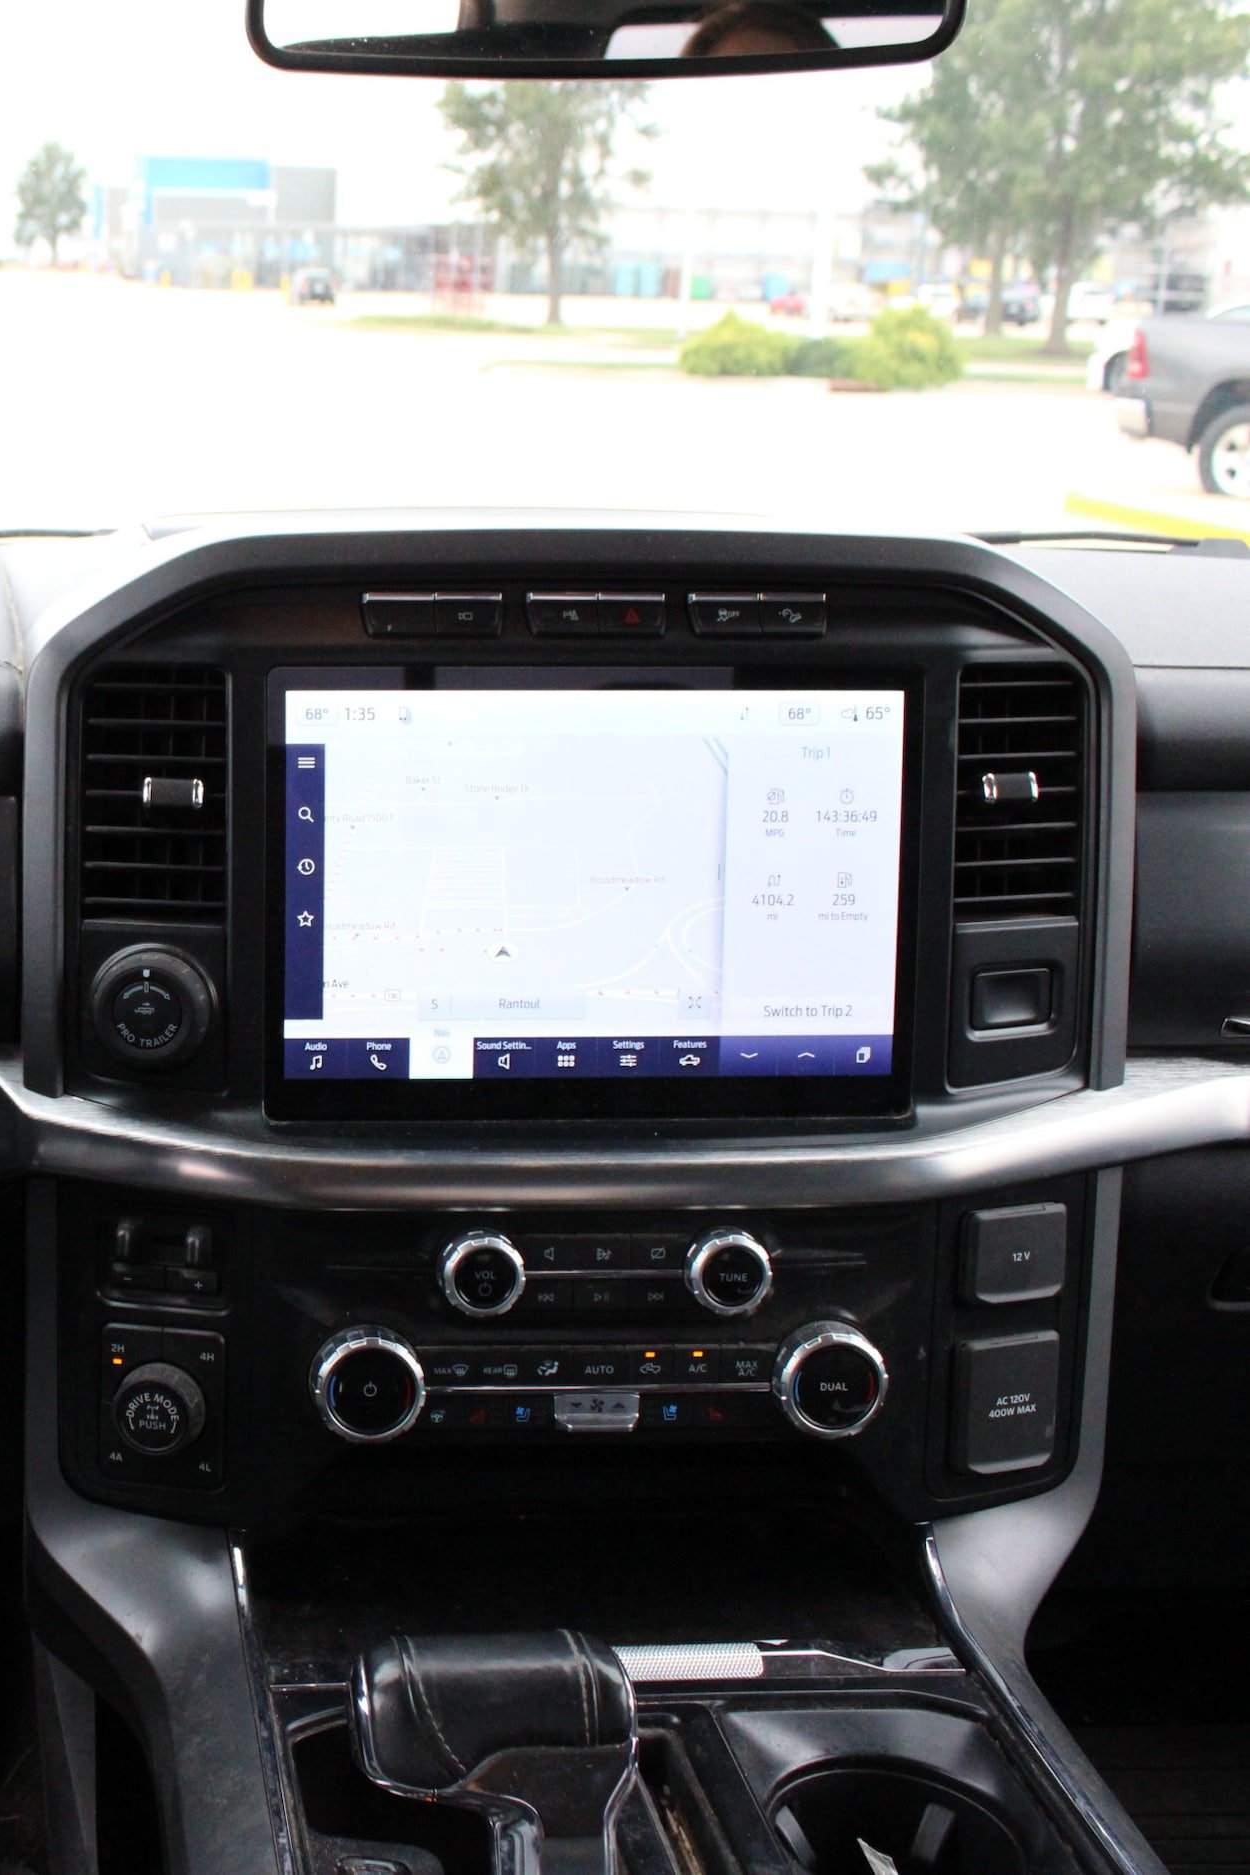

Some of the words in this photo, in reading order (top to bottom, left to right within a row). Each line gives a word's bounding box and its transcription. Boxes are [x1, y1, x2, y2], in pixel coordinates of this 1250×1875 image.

[305, 708, 329, 721] 68°
[344, 707, 376, 721] 1:35
[788, 707, 811, 721] 68°
[865, 706, 890, 721] 65°
[800, 746, 823, 761] Trip
[405, 776, 430, 785] Baker
[343, 813, 365, 822] Road
[762, 810, 789, 823] 20.8
[816, 810, 877, 823] 143:36:49
[765, 828, 784, 838] MPG
[836, 828, 857, 838] Time
[654, 875, 665, 885] Rd
[751, 893, 794, 907] 4104.2
[832, 894, 855, 906] 259
[767, 912, 778, 921] mi
[818, 912, 829, 921] mi
[830, 912, 840, 921] to
[840, 912, 868, 922] Empty
[331, 978, 349, 989] Ave
[431, 998, 438, 1010] S
[498, 998, 540, 1010] Rantoul
[763, 1005, 801, 1018] Switch
[803, 1006, 818, 1018] to
[821, 1005, 842, 1019] Trip
[845, 1005, 852, 1017] 2
[116, 1022, 136, 1043] PRO
[139, 1023, 178, 1048] TRAILER
[433, 1029, 450, 1038] Nav
[304, 1042, 328, 1051] Audio
[366, 1041, 392, 1051] Phone
[476, 1041, 502, 1050] Sound
[556, 1040, 577, 1051] Apps
[612, 1040, 645, 1051] Settings
[673, 1040, 707, 1049] Features
[1012, 1251, 1022, 1262] 12
[1023, 1250, 1031, 1261] V
[474, 1270, 496, 1280] VOL
[718, 1272, 748, 1282] TUNE
[110, 1343, 125, 1353] 2H
[198, 1352, 214, 1362] 4H
[584, 1364, 614, 1375] AUTO
[689, 1363, 707, 1374] A/C
[735, 1360, 758, 1368] MAX
[434, 1366, 453, 1375] MAX
[483, 1366, 504, 1375] REAR
[738, 1368, 756, 1377] A/C
[819, 1382, 848, 1392] DUAL
[996, 1395, 1009, 1406] AC
[1009, 1393, 1031, 1405] 120V
[125, 1392, 151, 1418] DRIVE
[153, 1393, 180, 1422] MODE
[988, 1406, 1015, 1419] 400W
[1017, 1403, 1037, 1415] MAX
[139, 1419, 167, 1430] PUSH
[109, 1451, 123, 1462] 4A
[198, 1461, 212, 1472] 4L
